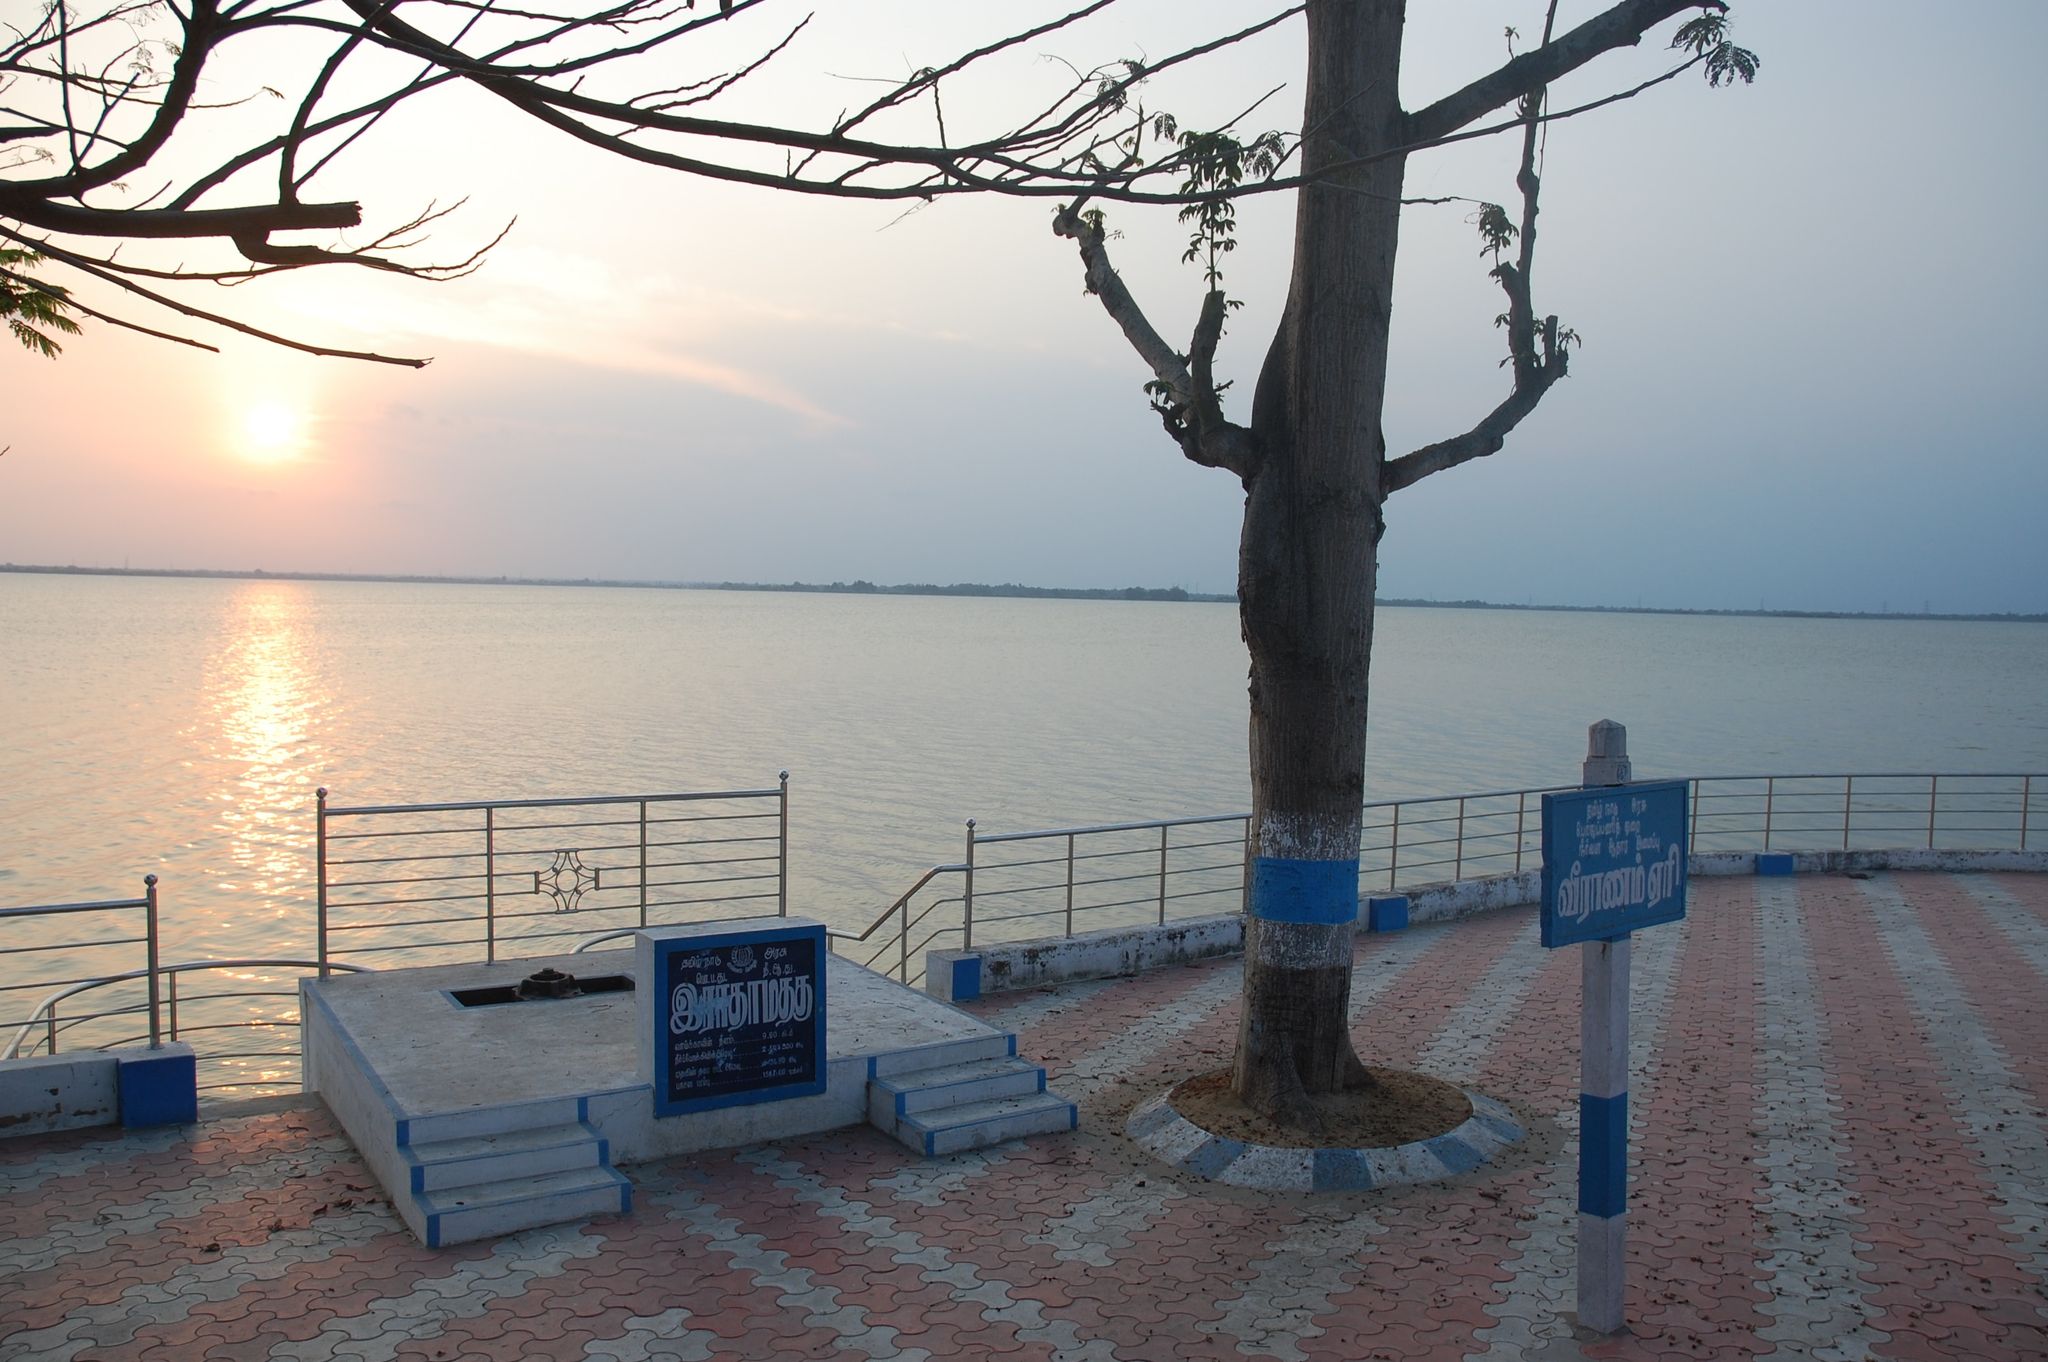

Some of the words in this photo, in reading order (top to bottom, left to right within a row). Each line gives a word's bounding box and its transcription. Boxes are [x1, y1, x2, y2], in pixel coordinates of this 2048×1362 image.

[1557, 852, 1645, 924] வீராணம்
[1648, 843, 1680, 908] ஏரி
[764, 947, 787, 960] அரசு
